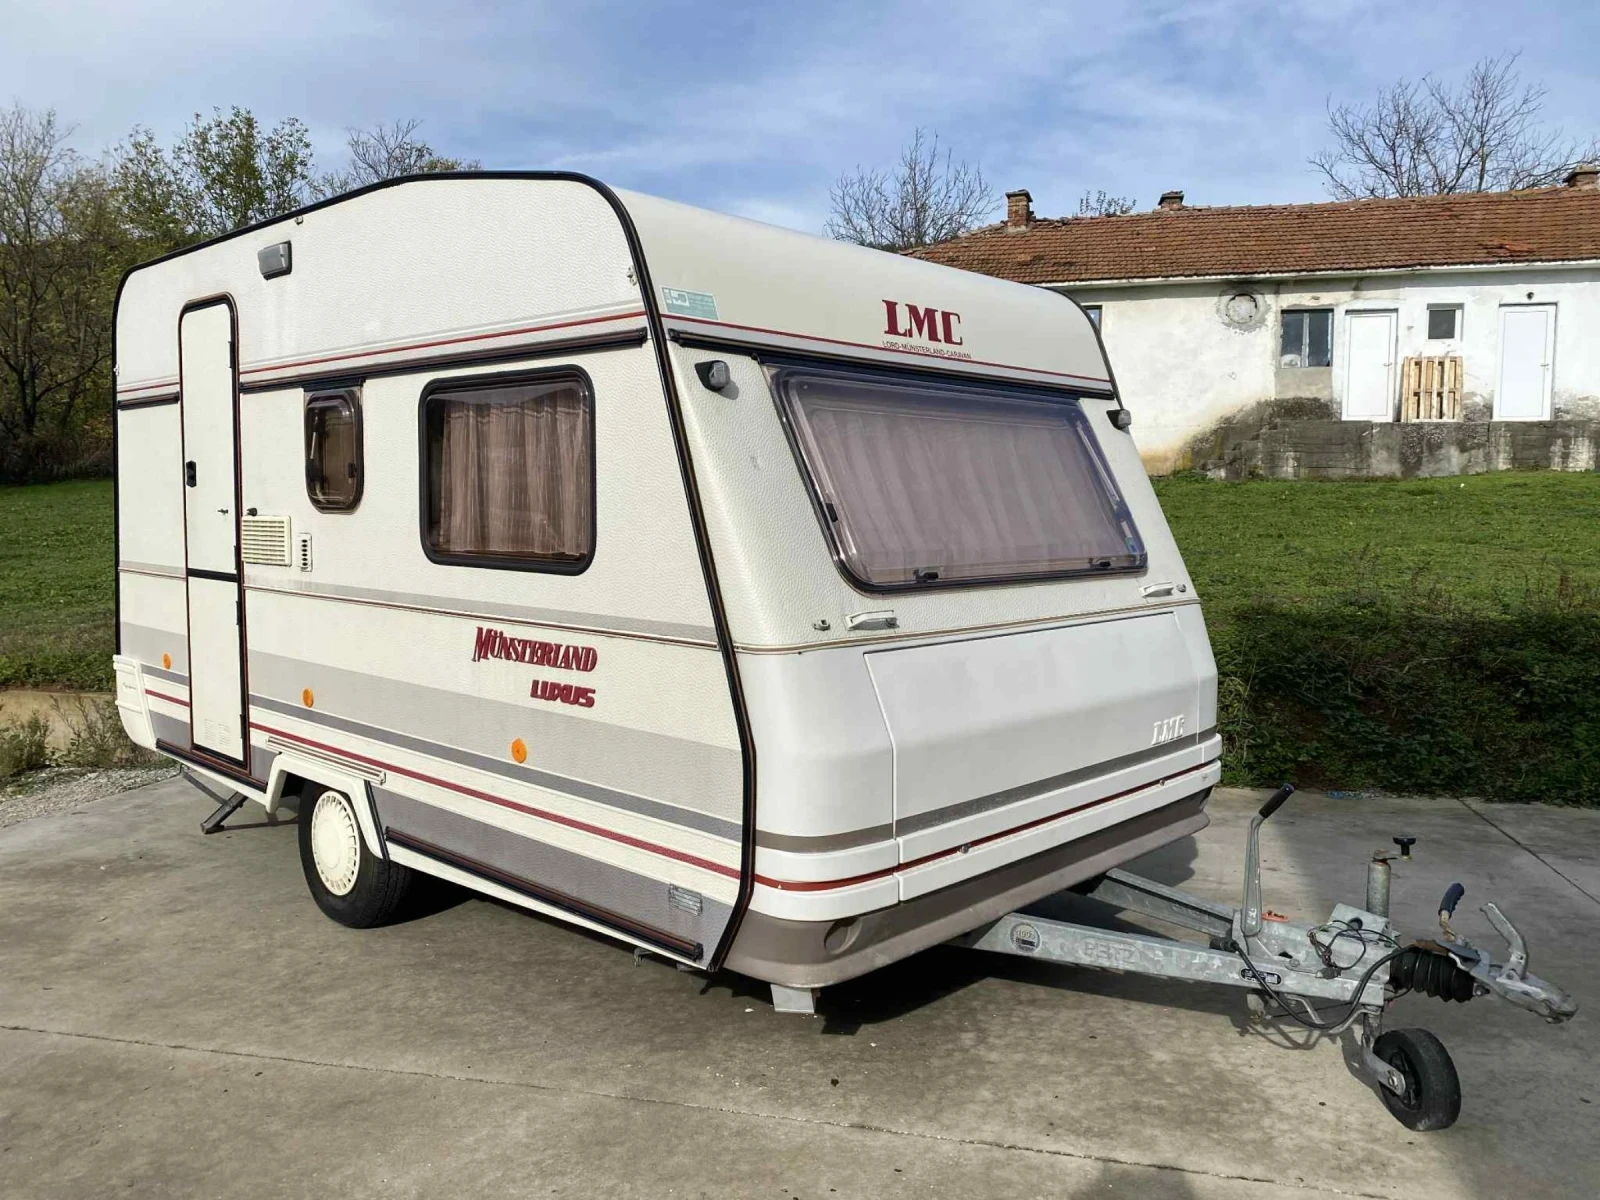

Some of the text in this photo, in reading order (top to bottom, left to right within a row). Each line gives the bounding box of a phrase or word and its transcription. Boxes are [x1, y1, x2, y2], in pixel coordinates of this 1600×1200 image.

[882, 299, 963, 346] LMC
[471, 626, 598, 673] MÜNSTERLAND
[530, 679, 596, 708] LUXUS
